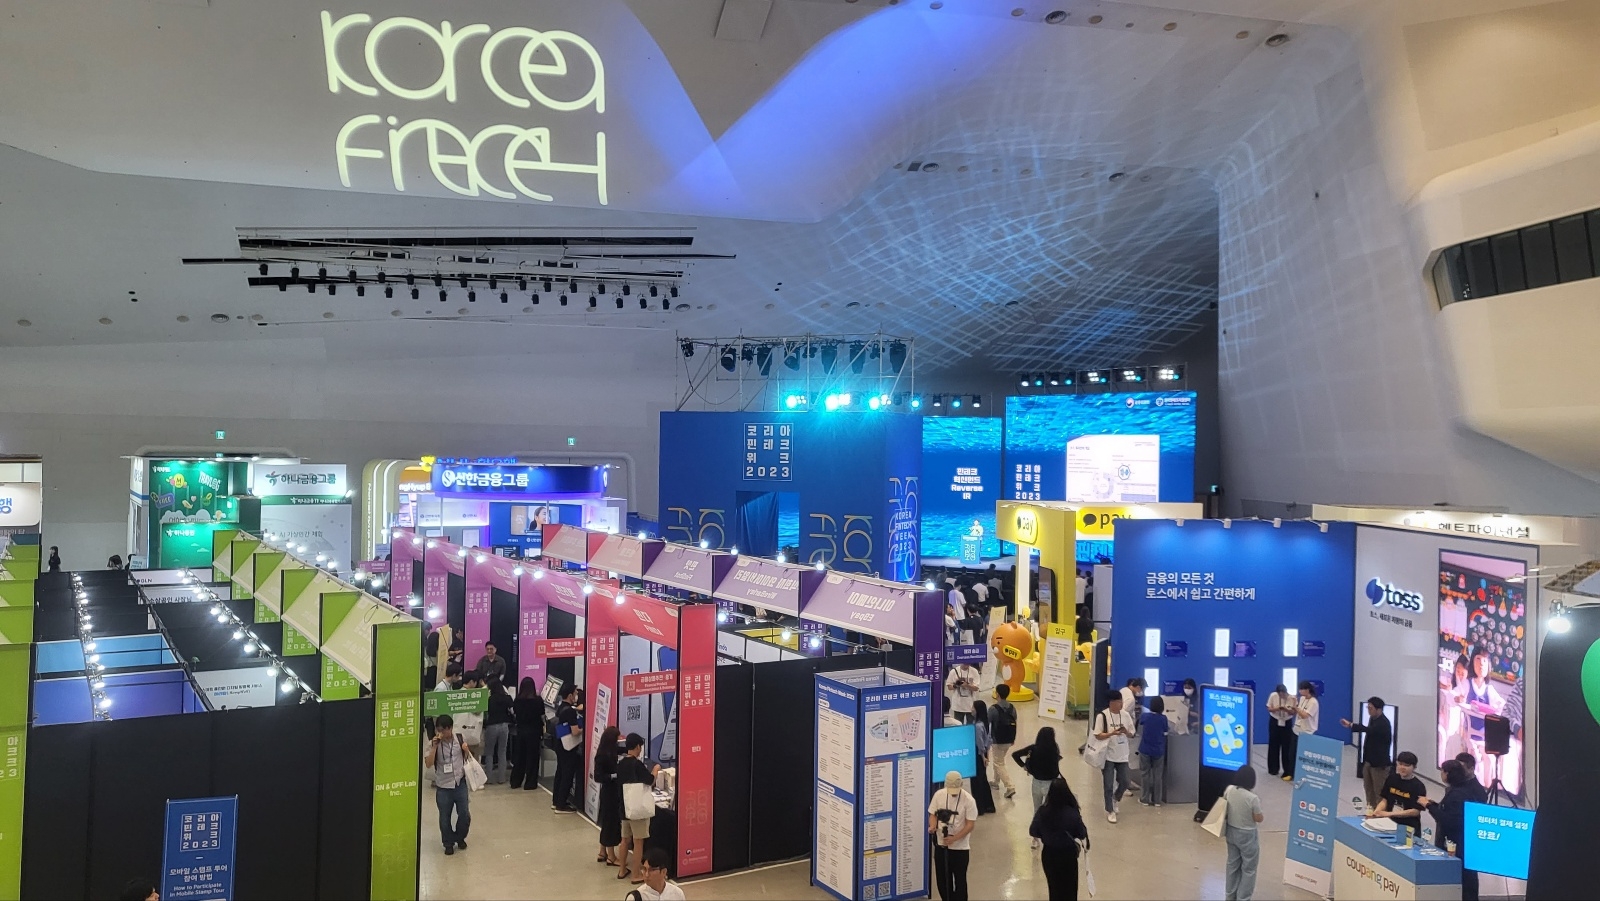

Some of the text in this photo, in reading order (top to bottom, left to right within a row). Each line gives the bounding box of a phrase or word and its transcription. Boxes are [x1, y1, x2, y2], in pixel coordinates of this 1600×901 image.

[746, 424, 790, 436] 코리아
[746, 438, 790, 450] 핀테크
[746, 453, 790, 464] 위크
[746, 466, 790, 477] 2023
[1016, 464, 1041, 473] 코리아
[281, 473, 336, 485] 하나금융그룹
[455, 472, 529, 487] 신한금융그룹
[951, 484, 983, 492] Reverse
[962, 492, 971, 500] IR
[1016, 492, 1041, 500] 2023
[895, 511, 912, 519] KOREA
[895, 521, 912, 530] FINTECH
[895, 533, 912, 541] WEEK
[895, 542, 912, 551] 2023
[1145, 572, 1215, 585] 금융의 모든 것
[1145, 587, 1256, 601] 토스에서 쉽고 간편하게
[1385, 586, 1421, 611] toss
[1055, 627, 1066, 635] 입구
[590, 636, 615, 644] 코리아
[684, 674, 711, 683] 코리아
[326, 680, 355, 688] 2023
[684, 682, 711, 691] 핀테크
[684, 690, 711, 699] 위크
[865, 695, 881, 703] 코리아
[883, 693, 898, 701] 핀테크
[381, 700, 415, 710] 코리아
[684, 698, 711, 707] 2023
[381, 708, 415, 719] 핀테크
[381, 718, 415, 728] 위크
[381, 726, 415, 737] 2023
[375, 784, 385, 792] ON
[391, 782, 404, 791] OFF
[405, 780, 417, 788] Lab
[389, 789, 402, 797] Inc.
[182, 814, 219, 823] 코리아
[1477, 815, 1528, 830] 원터치 결제 설정
[182, 822, 219, 832] 핀테크
[182, 832, 219, 841] 위크
[1477, 829, 1500, 841] 완료!
[182, 840, 219, 849] 2023
[168, 864, 228, 875] 모바일 스탬프 투어
[183, 873, 213, 882] 참여 방법
[1346, 855, 1400, 898] coupang pay
[194, 881, 222, 891] Participate
[175, 889, 193, 897] Mobile
[194, 889, 211, 898] Stamp
[211, 887, 225, 895] Tour
